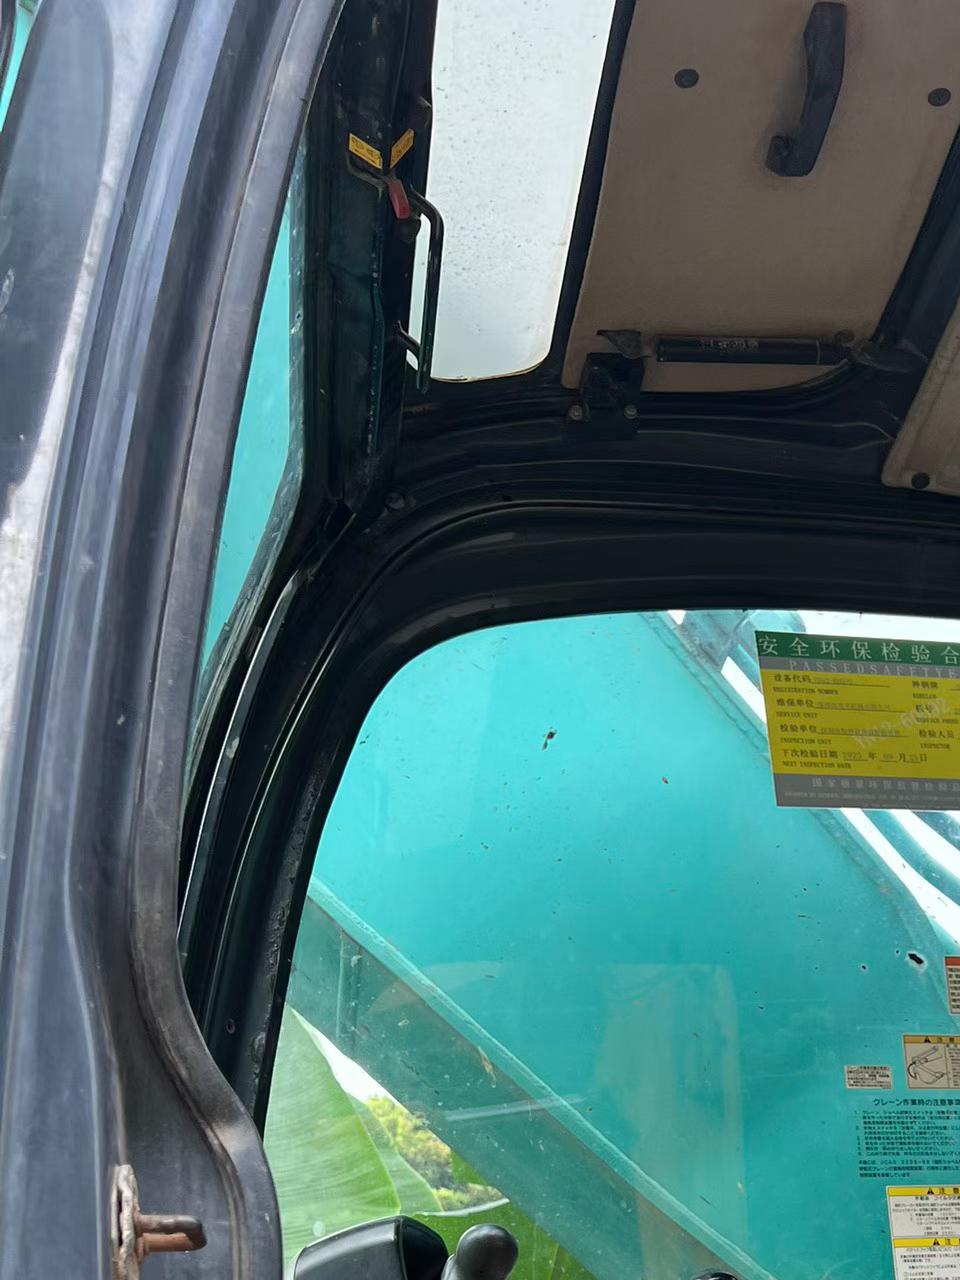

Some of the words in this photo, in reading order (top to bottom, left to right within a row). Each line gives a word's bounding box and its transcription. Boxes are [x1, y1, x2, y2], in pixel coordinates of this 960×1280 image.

[782, 749, 838, 759] 下次检验日期
